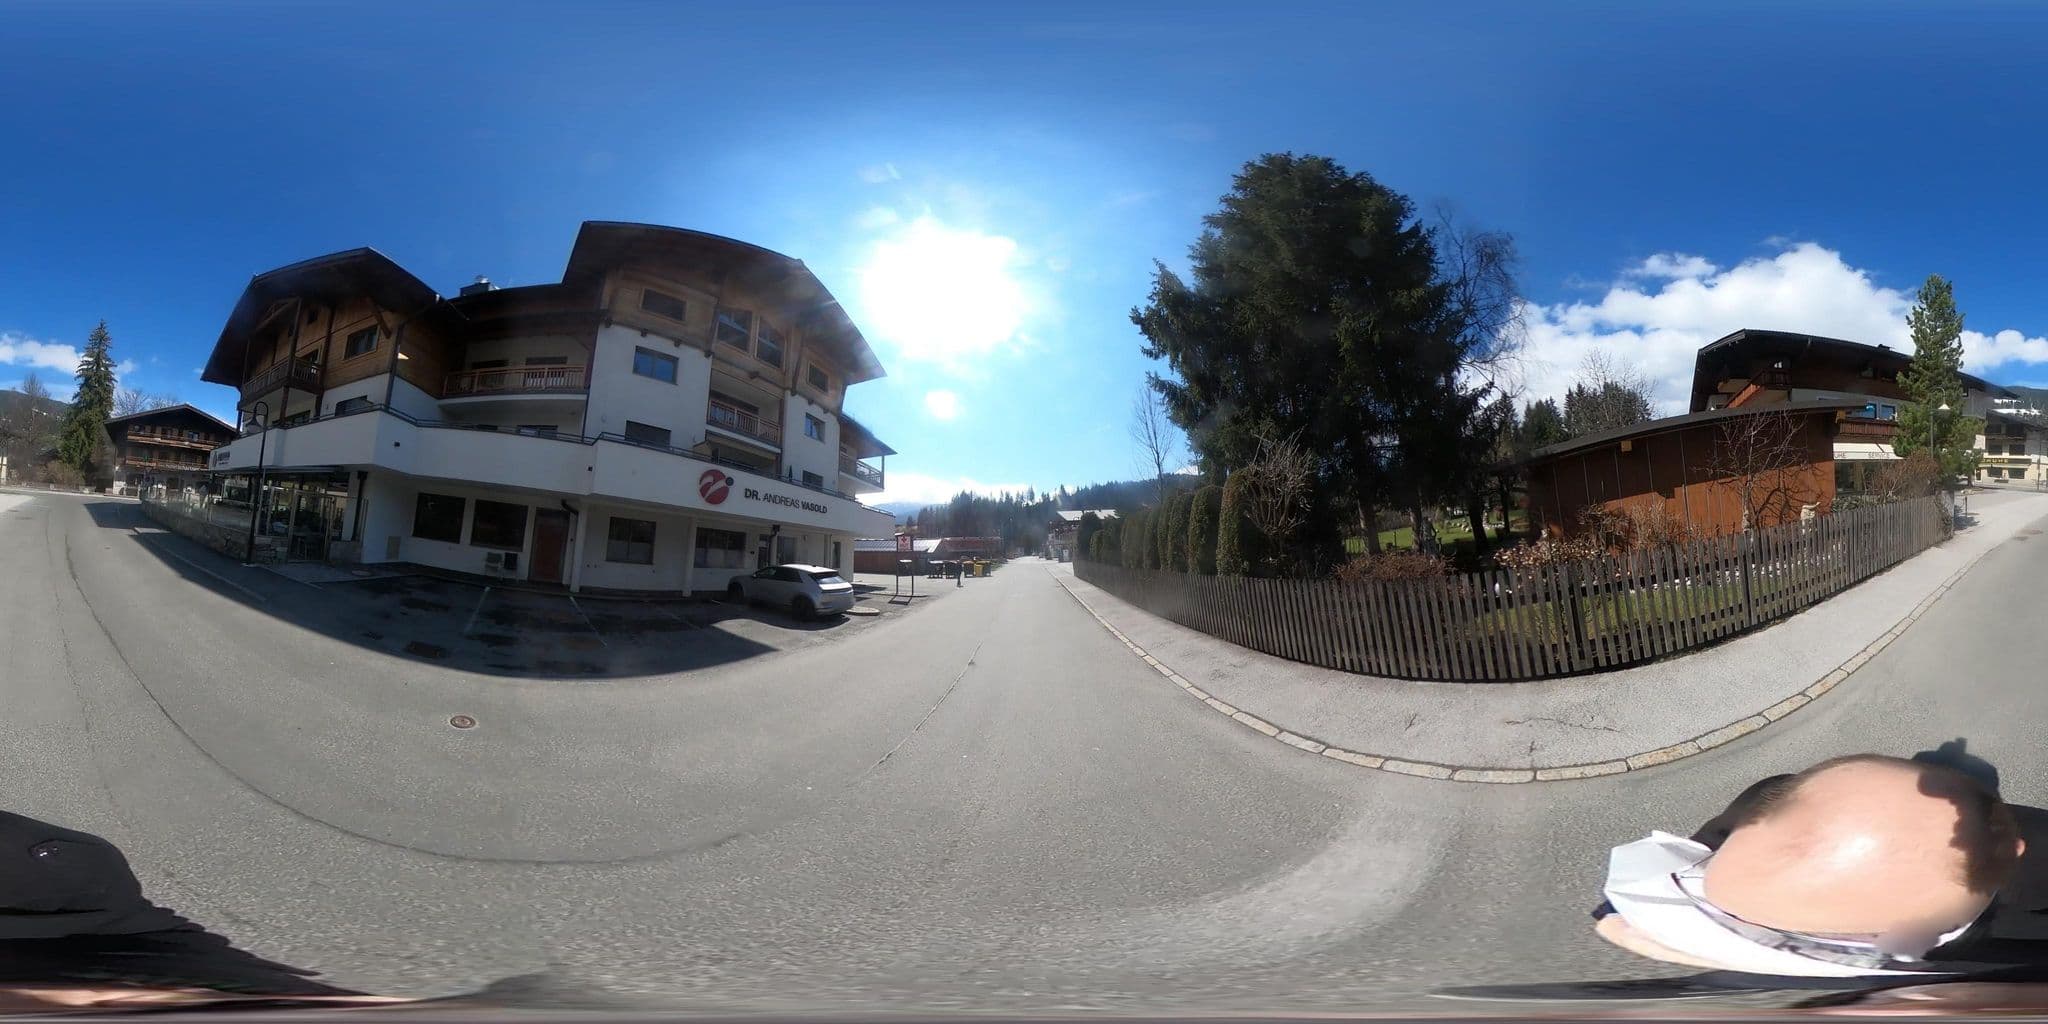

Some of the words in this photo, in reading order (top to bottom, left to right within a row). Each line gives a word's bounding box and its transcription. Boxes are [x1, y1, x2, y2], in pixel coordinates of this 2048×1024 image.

[744, 488, 761, 501] DR.
[763, 493, 800, 509] ANDREAS
[801, 500, 828, 513] VASOLD
